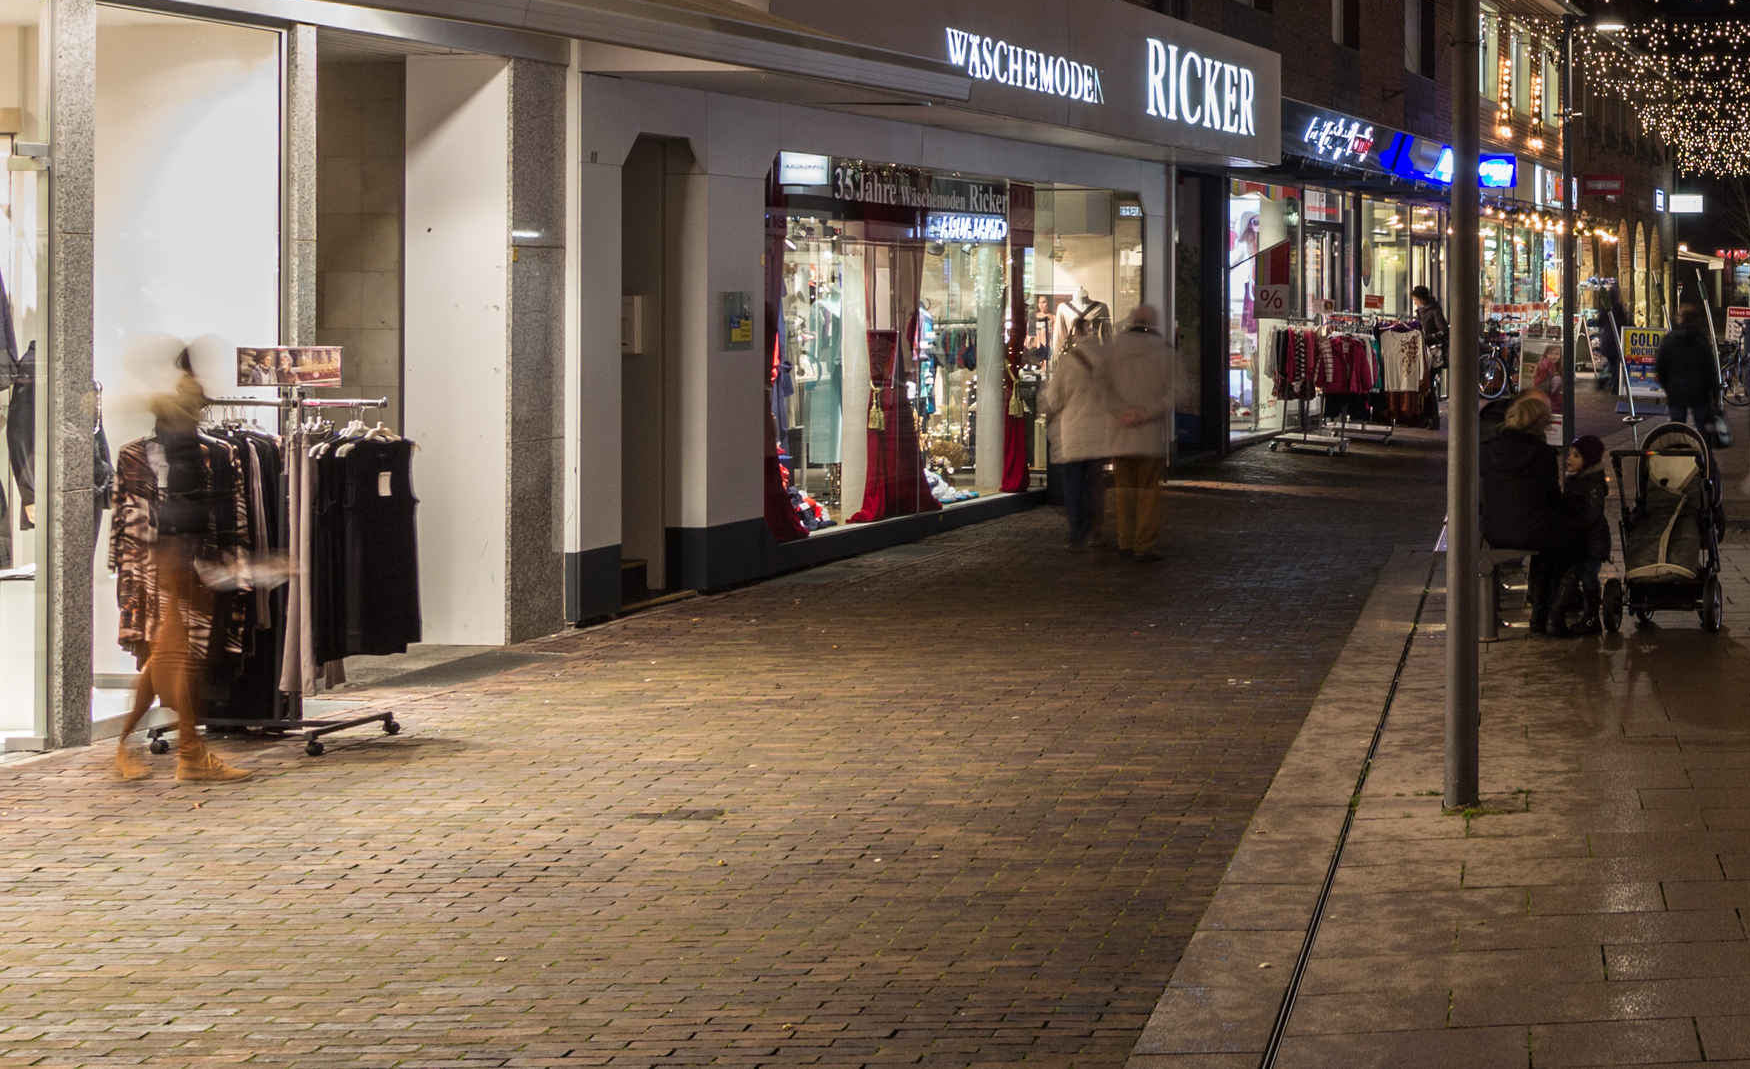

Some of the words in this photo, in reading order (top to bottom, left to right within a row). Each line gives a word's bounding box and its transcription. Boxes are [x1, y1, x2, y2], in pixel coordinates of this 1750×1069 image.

[946, 27, 1104, 105] WÄSCHEMODEN
[1146, 38, 1255, 136] RICKER
[834, 166, 854, 200] 35
[855, 170, 897, 205] Jahre
[901, 184, 966, 212] Wäschemoden
[969, 183, 1008, 215] Ricker
[1587, 180, 1606, 188] Street
[1607, 180, 1619, 188] One
[1630, 333, 1660, 347] GOLD
